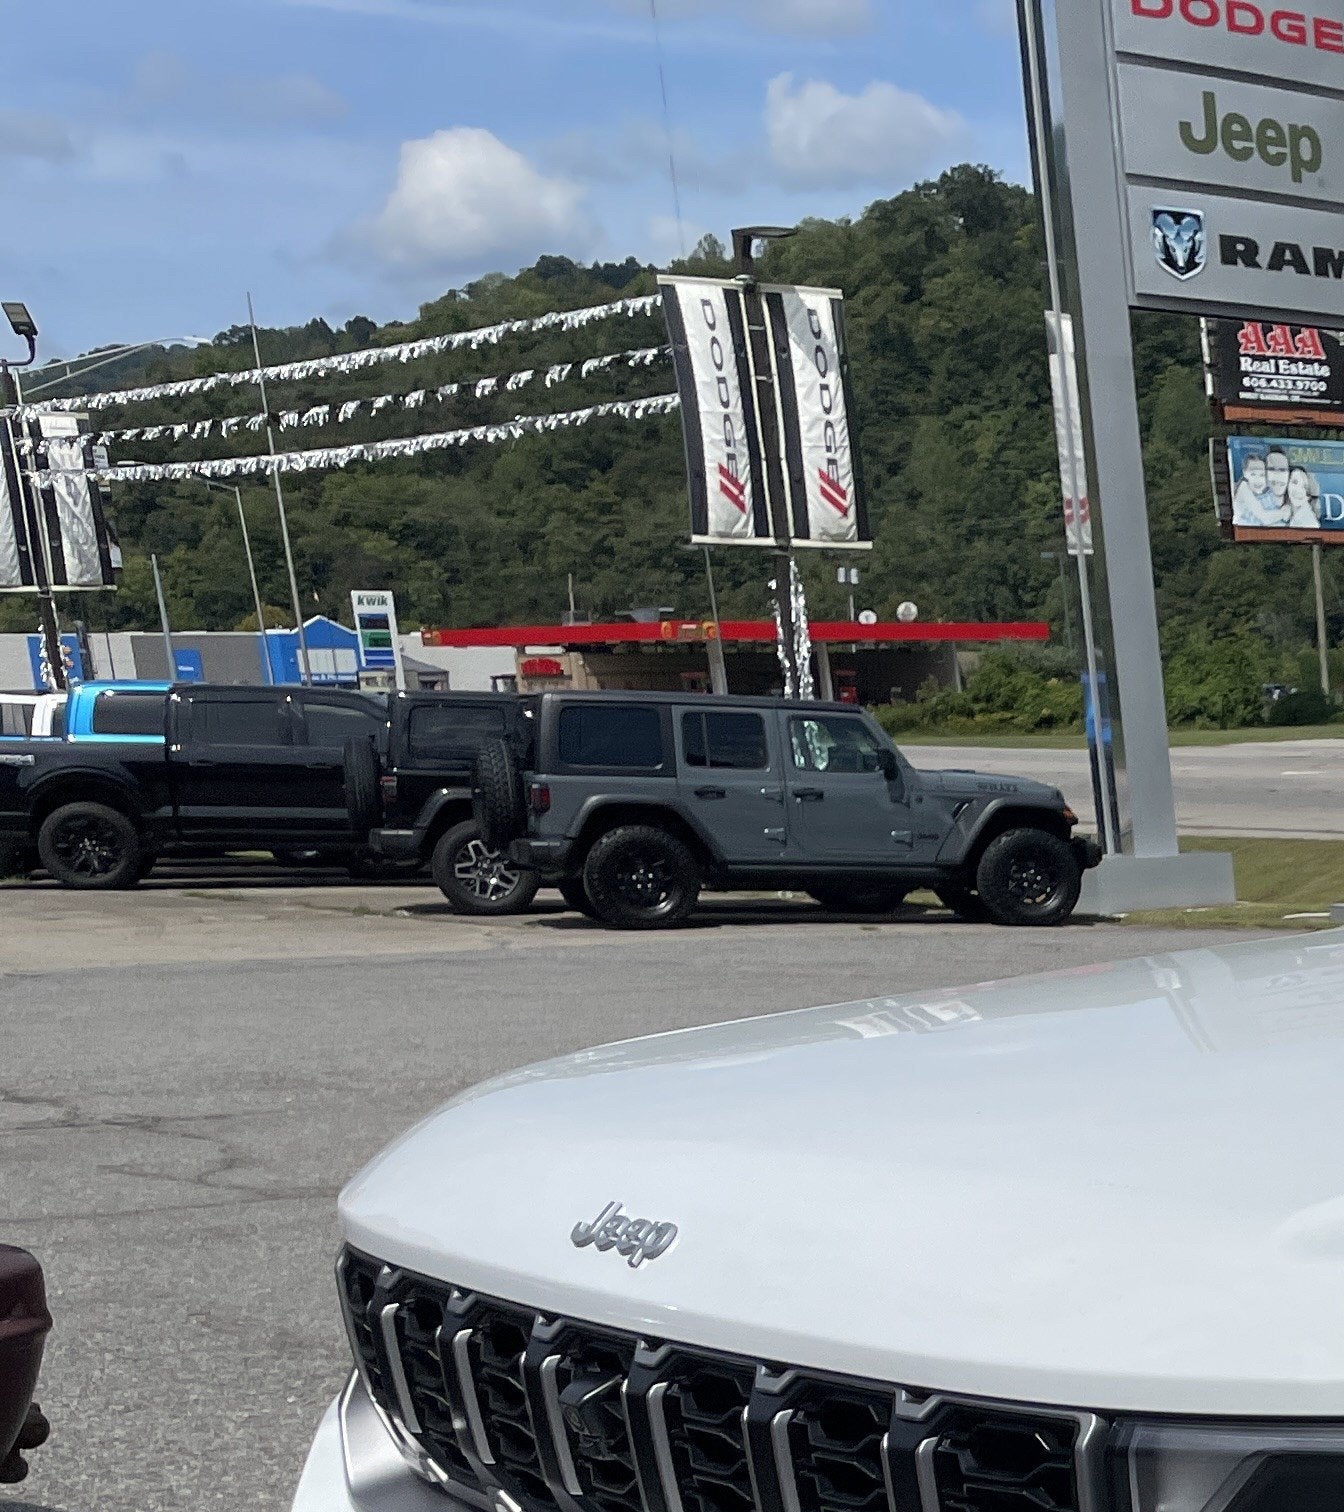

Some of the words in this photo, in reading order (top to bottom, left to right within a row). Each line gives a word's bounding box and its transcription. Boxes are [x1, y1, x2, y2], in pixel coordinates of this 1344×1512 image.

[1178, 90, 1322, 183] Jeep
[1237, 321, 1327, 360] AAA
[1240, 356, 1276, 373] Real
[1278, 359, 1331, 377] Estate
[701, 298, 741, 479] DODGE
[807, 308, 840, 486] DODGE
[570, 1201, 679, 1269] Jeep
